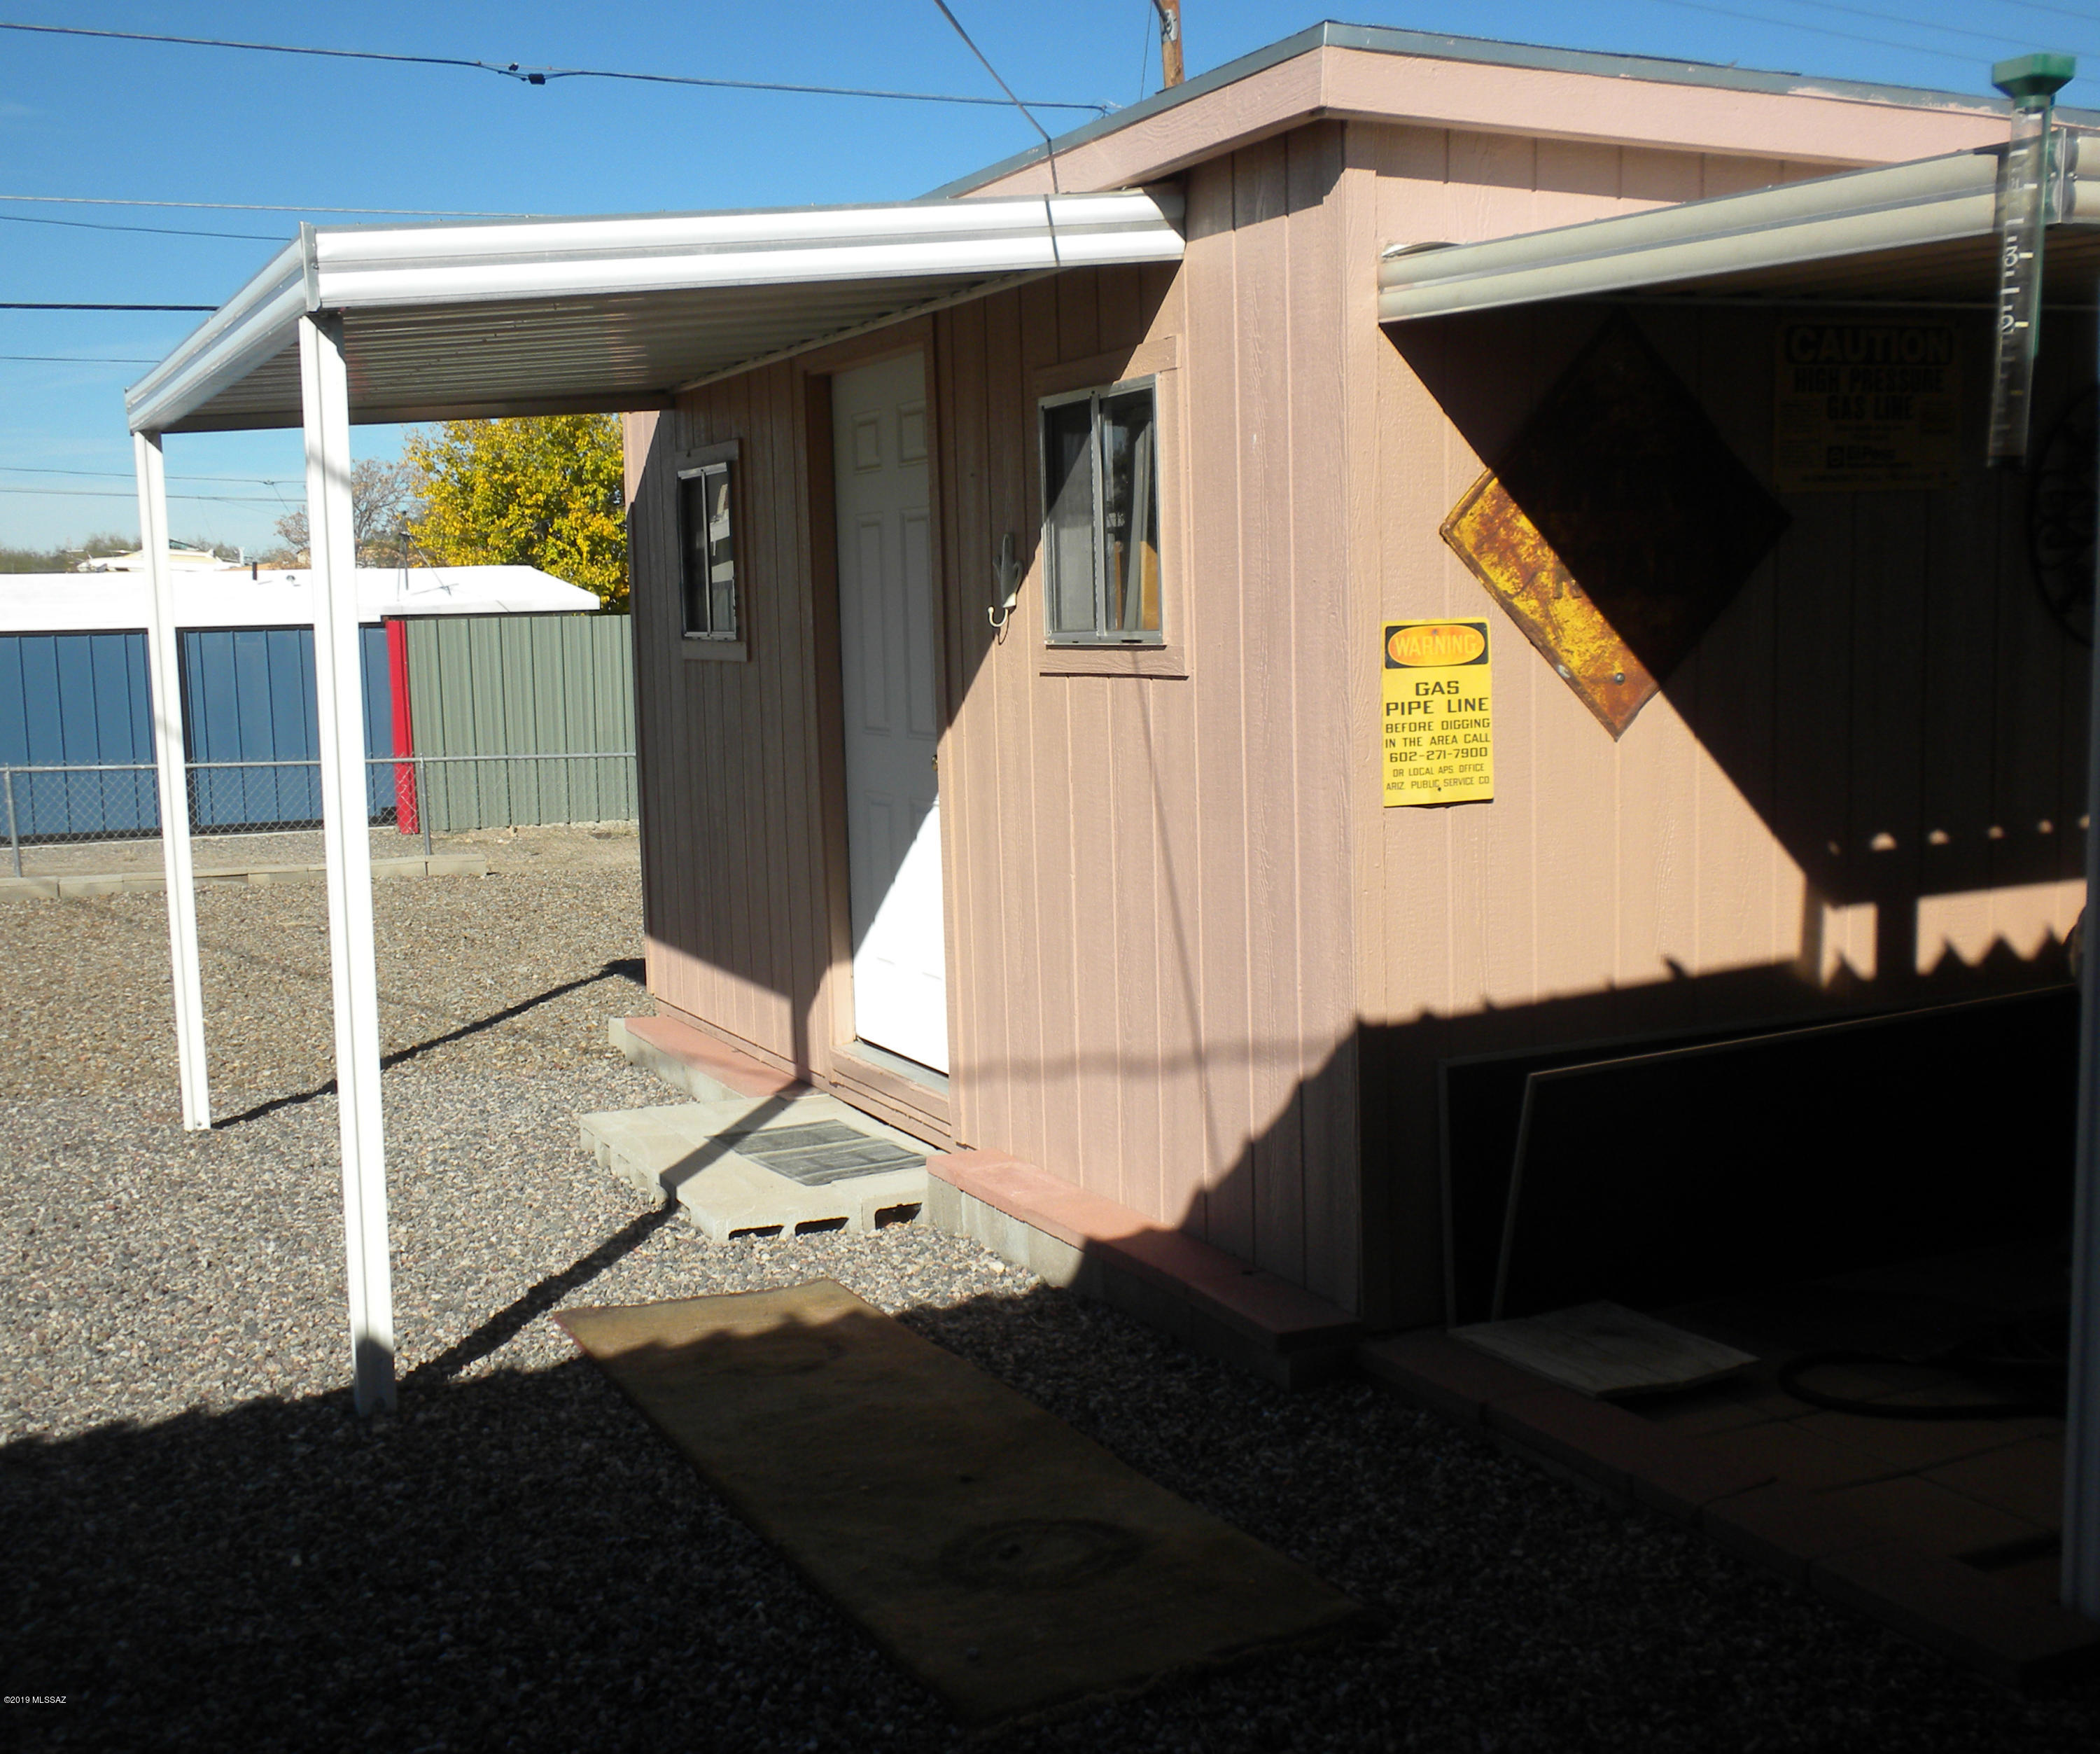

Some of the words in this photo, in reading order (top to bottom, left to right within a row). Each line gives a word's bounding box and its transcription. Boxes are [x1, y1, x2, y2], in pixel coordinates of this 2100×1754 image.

[2004, 245, 2019, 267] 3
[2000, 315, 2015, 335] 2
[1791, 328, 1951, 363] CAUTION
[1794, 368, 1840, 392] HIGH
[1849, 368, 1944, 392] PRESSURE
[1827, 395, 1865, 419] GAS
[1873, 395, 1916, 419] LINE
[1394, 634, 1477, 657] WARNING
[1415, 681, 1460, 696] GAS
[1386, 700, 1434, 716] PIPE
[1447, 697, 1489, 713] LINE
[1385, 721, 1434, 733] BEFORE
[1441, 718, 1490, 730] DIGGING
[1385, 738, 1396, 749] IN
[1403, 737, 1422, 747] THE
[1429, 735, 1459, 745] AREA
[1464, 733, 1490, 744] CALL
[1390, 746, 1488, 763] 602-271-7900
[1393, 769, 1404, 777] OR
[1408, 767, 1434, 776] LOCAL
[1459, 763, 1485, 773] OFFICE
[1410, 779, 1440, 789] PUBLIC
[1443, 777, 1474, 787] SERVICE
